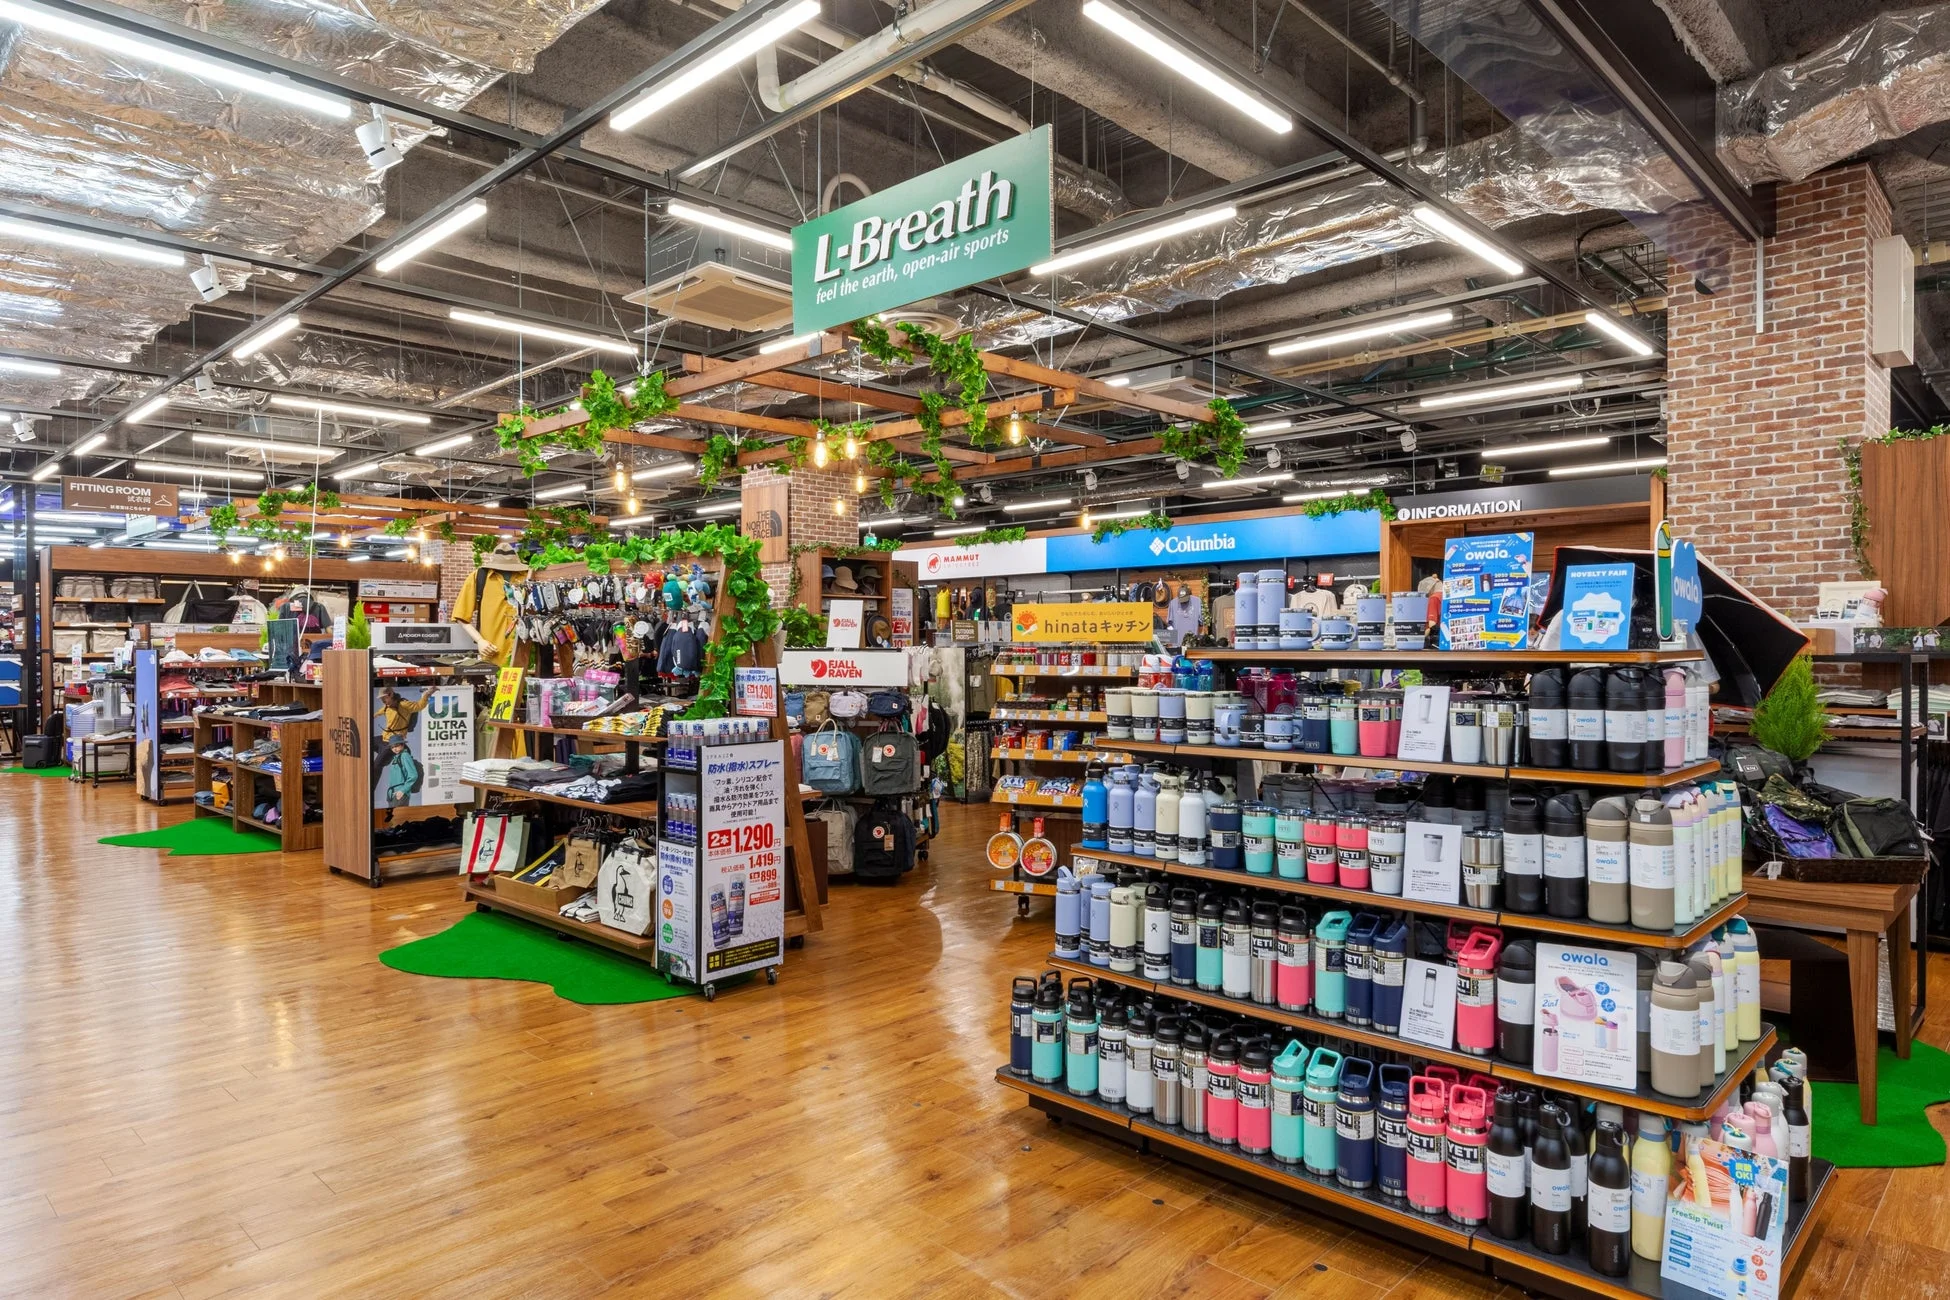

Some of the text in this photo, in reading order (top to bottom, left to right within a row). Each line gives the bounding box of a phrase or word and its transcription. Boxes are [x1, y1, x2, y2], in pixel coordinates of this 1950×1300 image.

[814, 169, 1015, 283] L-Breath
[816, 228, 1010, 305] feel the earth, open-air sports
[70, 482, 151, 497] FITTING ROOM
[756, 510, 770, 520] THE
[1410, 499, 1522, 521] INFORMATION
[746, 520, 770, 531] NORTH
[753, 529, 771, 539] FACE
[1165, 533, 1236, 554] Columbia
[944, 554, 979, 563] MAMMUT
[1465, 547, 1509, 561] owala
[1673, 575, 1699, 604] owala
[828, 659, 857, 669] FJALL
[828, 669, 863, 679] RAVEN
[427, 695, 467, 719] UL
[338, 717, 350, 730] THE
[427, 720, 467, 730] ULTRA
[329, 729, 350, 743] NORTH
[427, 730, 467, 741] LIGHT
[335, 743, 350, 757] FACE
[708, 759, 780, 775] 防水(撥水)スプレー
[715, 774, 773, 786] フッ素、シリコン配合で
[709, 798, 779, 813] 雨具からアウトドア用品まで
[710, 833, 729, 848] 2本
[1277, 842, 1296, 850] YETI
[708, 848, 732, 857] 本体価格
[1307, 846, 1327, 855] YETI
[1340, 850, 1360, 859] YETI
[1371, 855, 1390, 864] YETI
[721, 863, 745, 873] 税込価格
[761, 869, 777, 882] 899
[1252, 938, 1273, 948] YETI
[1561, 952, 1609, 967] owala
[1542, 998, 1559, 1008] 2in1
[1100, 1039, 1122, 1051] YETI
[1153, 1055, 1174, 1070] YETI
[1208, 1073, 1230, 1087] YETI
[1303, 1102, 1317, 1116] ETI
[1336, 1112, 1353, 1125] ETI
[1379, 1118, 1407, 1134] YETI
[1407, 1131, 1434, 1149] YETI
[1448, 1141, 1478, 1159] YETI
[1671, 1207, 1702, 1223] FreeSip
[1703, 1217, 1724, 1231] Twist
[1753, 1245, 1775, 1257] 2in1
[1707, 1286, 1727, 1297] owala
